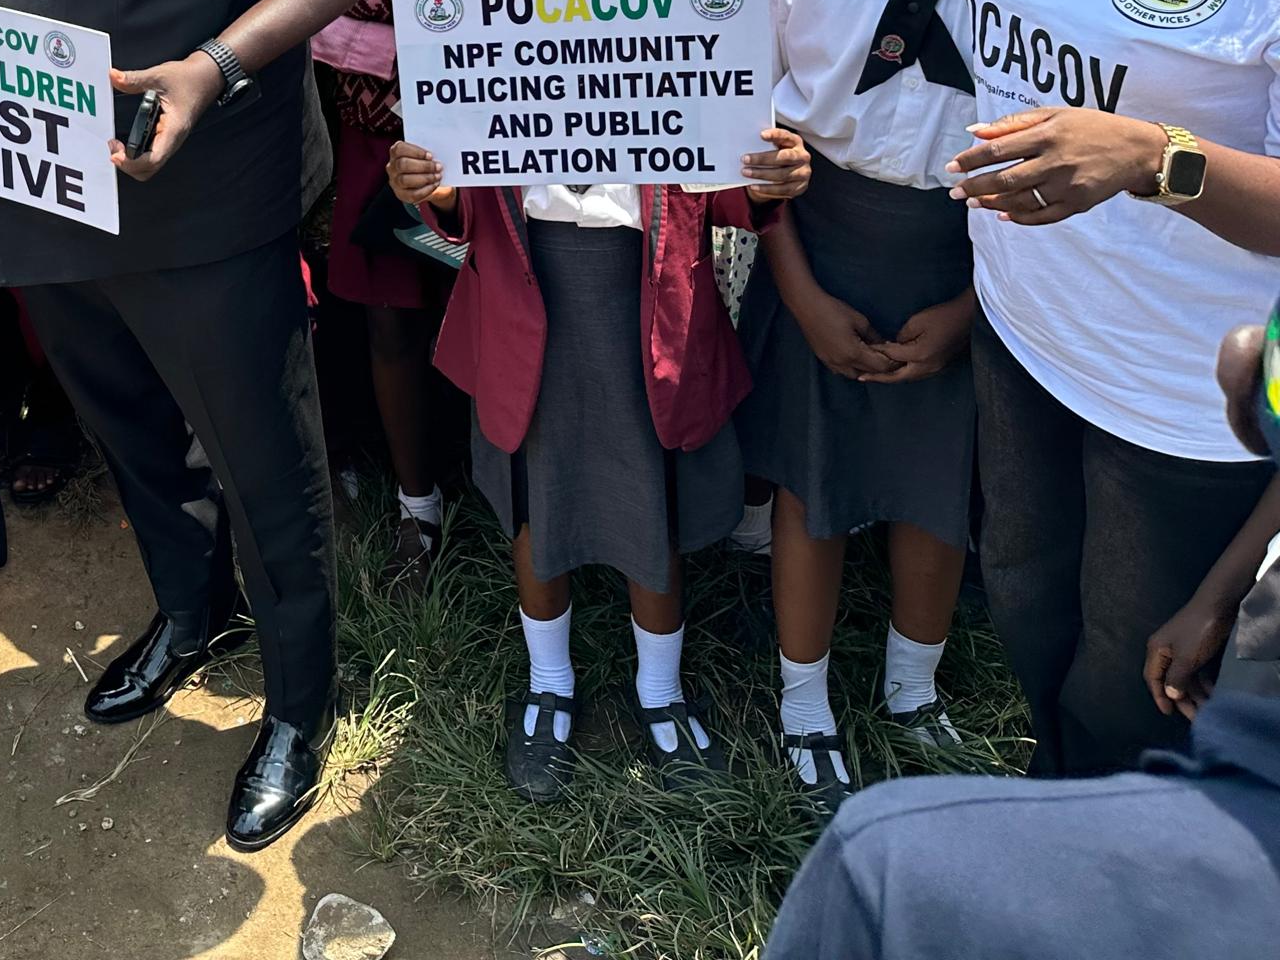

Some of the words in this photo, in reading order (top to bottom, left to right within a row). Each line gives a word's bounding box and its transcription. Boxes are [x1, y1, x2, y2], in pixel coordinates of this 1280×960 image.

[1124, 2, 1156, 22] OTHER
[1158, 14, 1191, 24] VICES
[443, 42, 503, 70] NPF
[514, 34, 720, 66] COMMUNITY
[416, 74, 566, 105] POLICING
[577, 70, 754, 100] INITIATIVE
[487, 112, 553, 139] AND
[565, 109, 684, 137] PUBLIC
[461, 147, 616, 175] RELATION
[627, 146, 716, 173] TOOL
